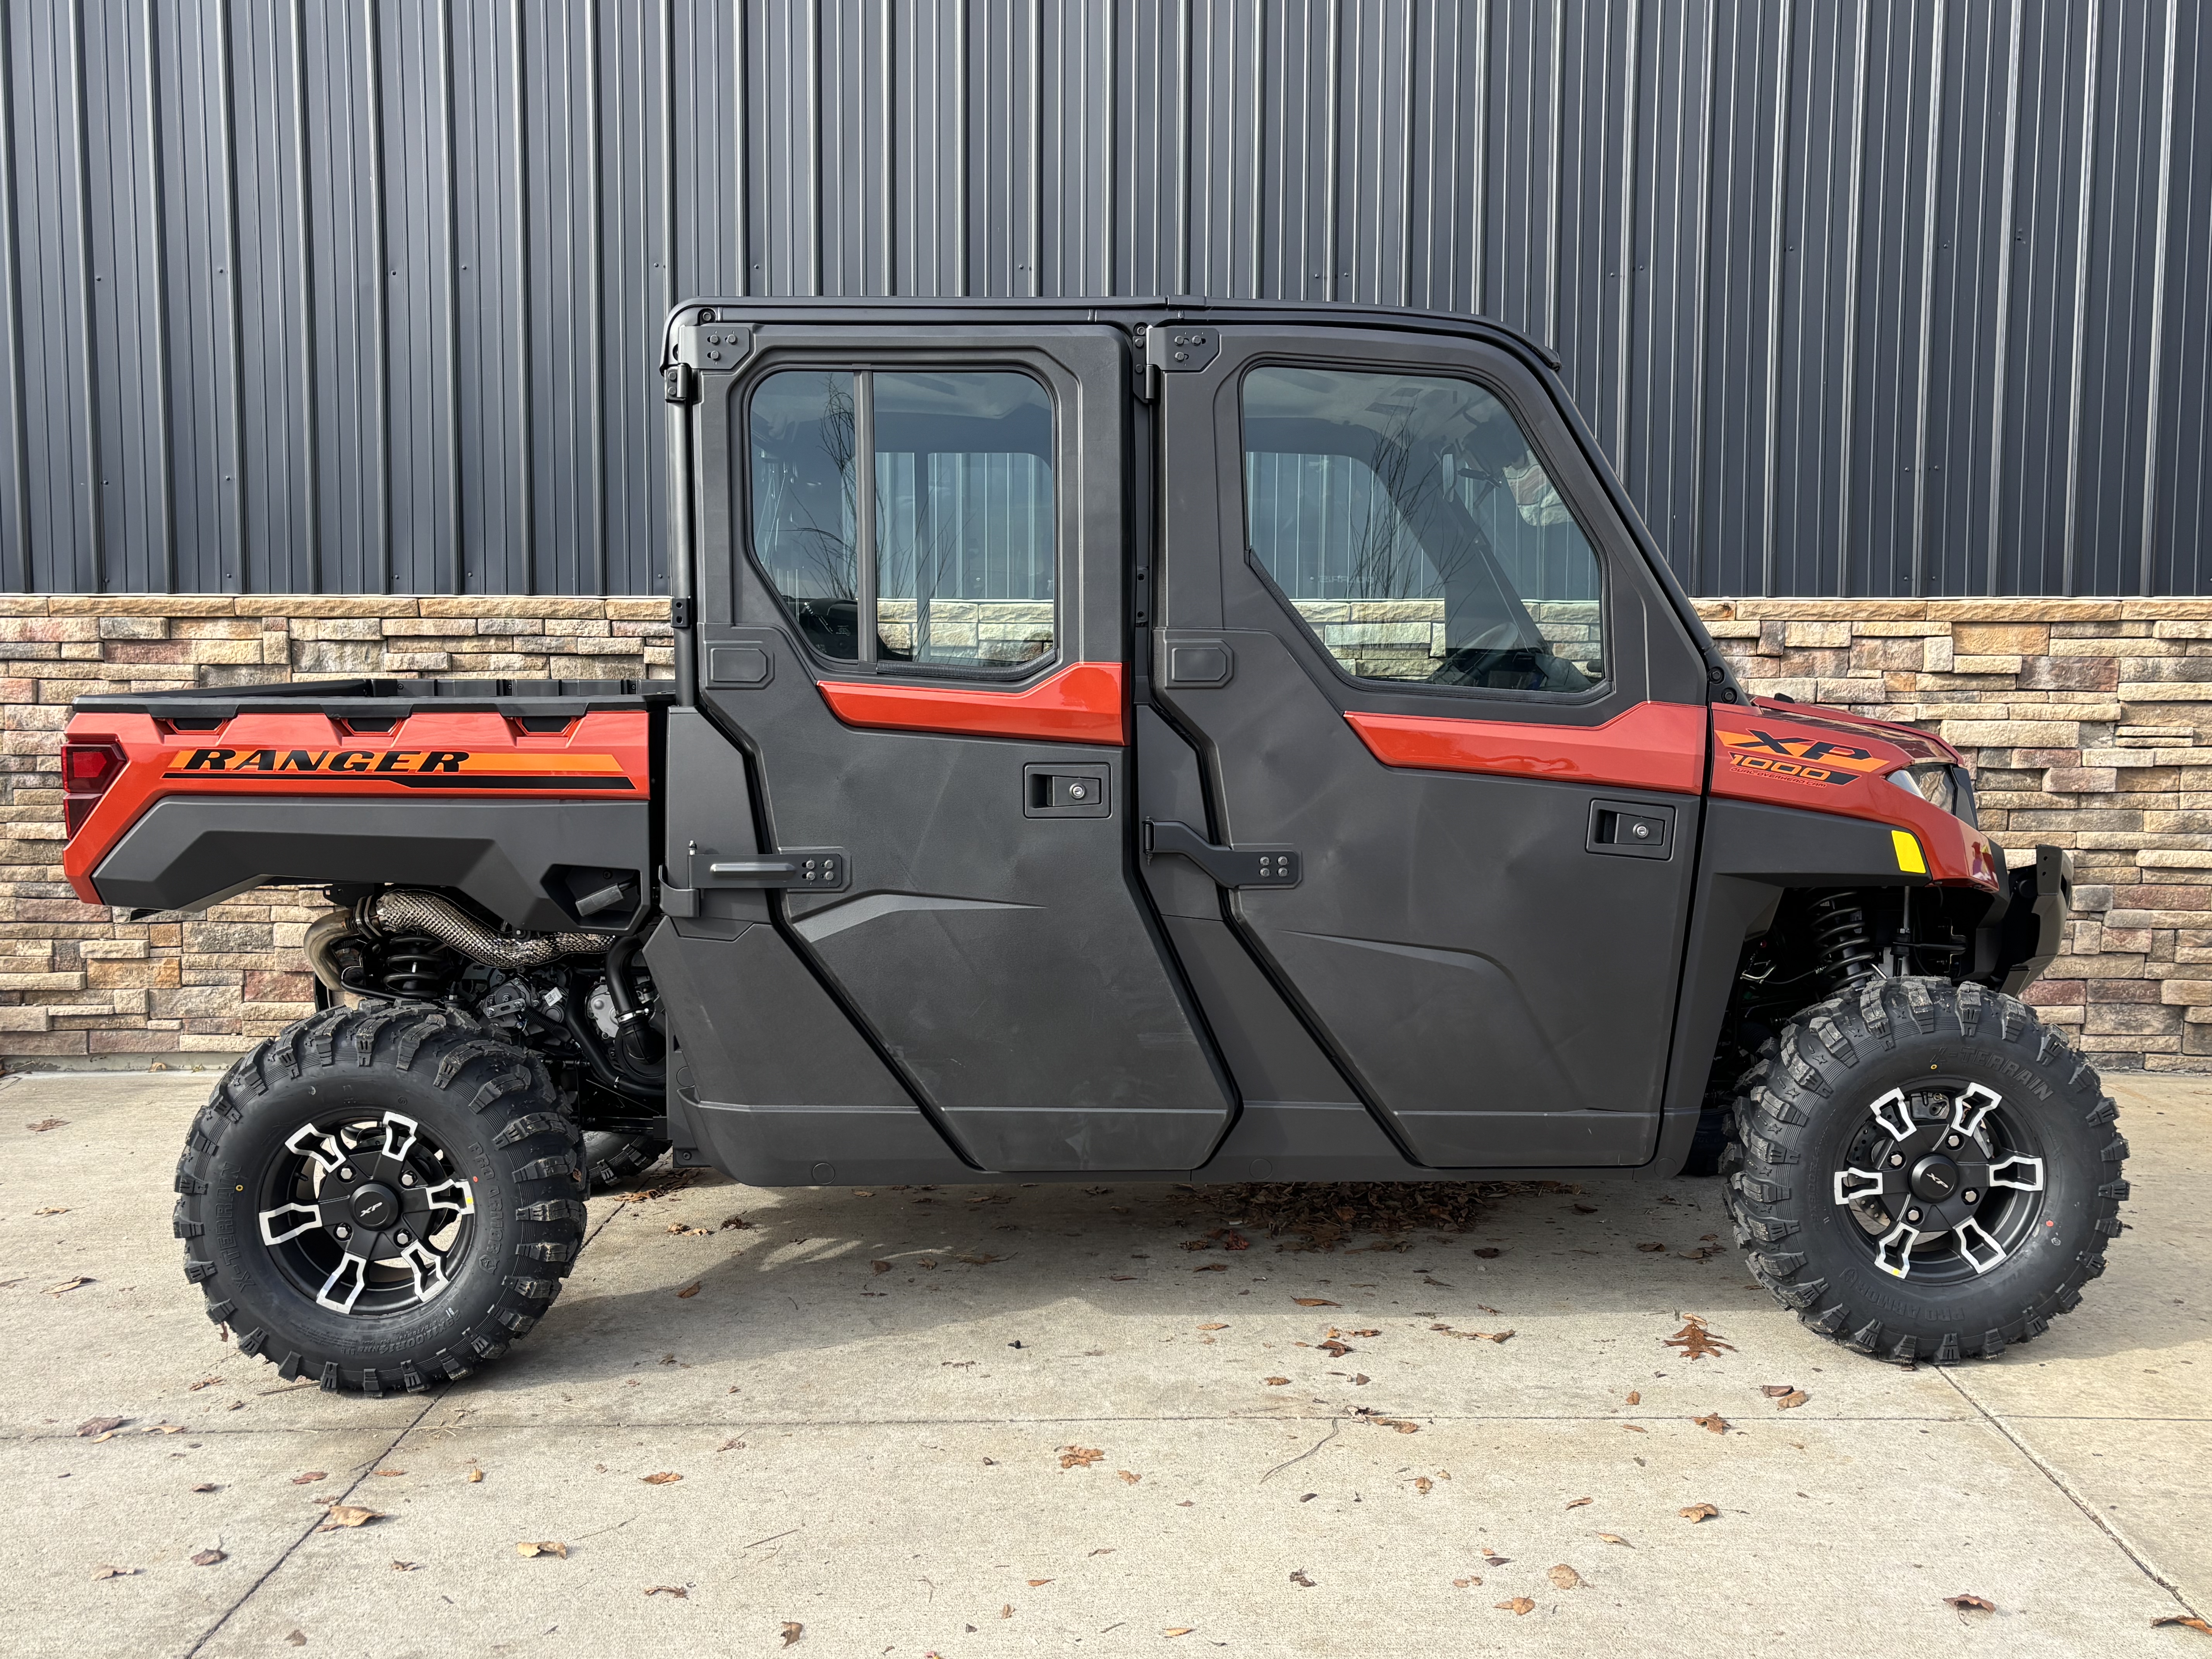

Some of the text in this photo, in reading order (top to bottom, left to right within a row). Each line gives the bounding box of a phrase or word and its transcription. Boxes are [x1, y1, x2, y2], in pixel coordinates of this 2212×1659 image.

[1727, 729, 1872, 760] XP
[183, 749, 469, 772] RANGER
[1730, 755, 1831, 780] 1000
[1757, 772, 1805, 784] OVERHEAD
[1930, 1046, 2054, 1101] X-TERRAIN
[1926, 1173, 1948, 1188] XP
[360, 1202, 383, 1217] XP
[468, 1141, 503, 1254] PRO ARMOR
[215, 1161, 256, 1293] X-TERRAIN
[1855, 1279, 1965, 1322] PRO ARMOR
